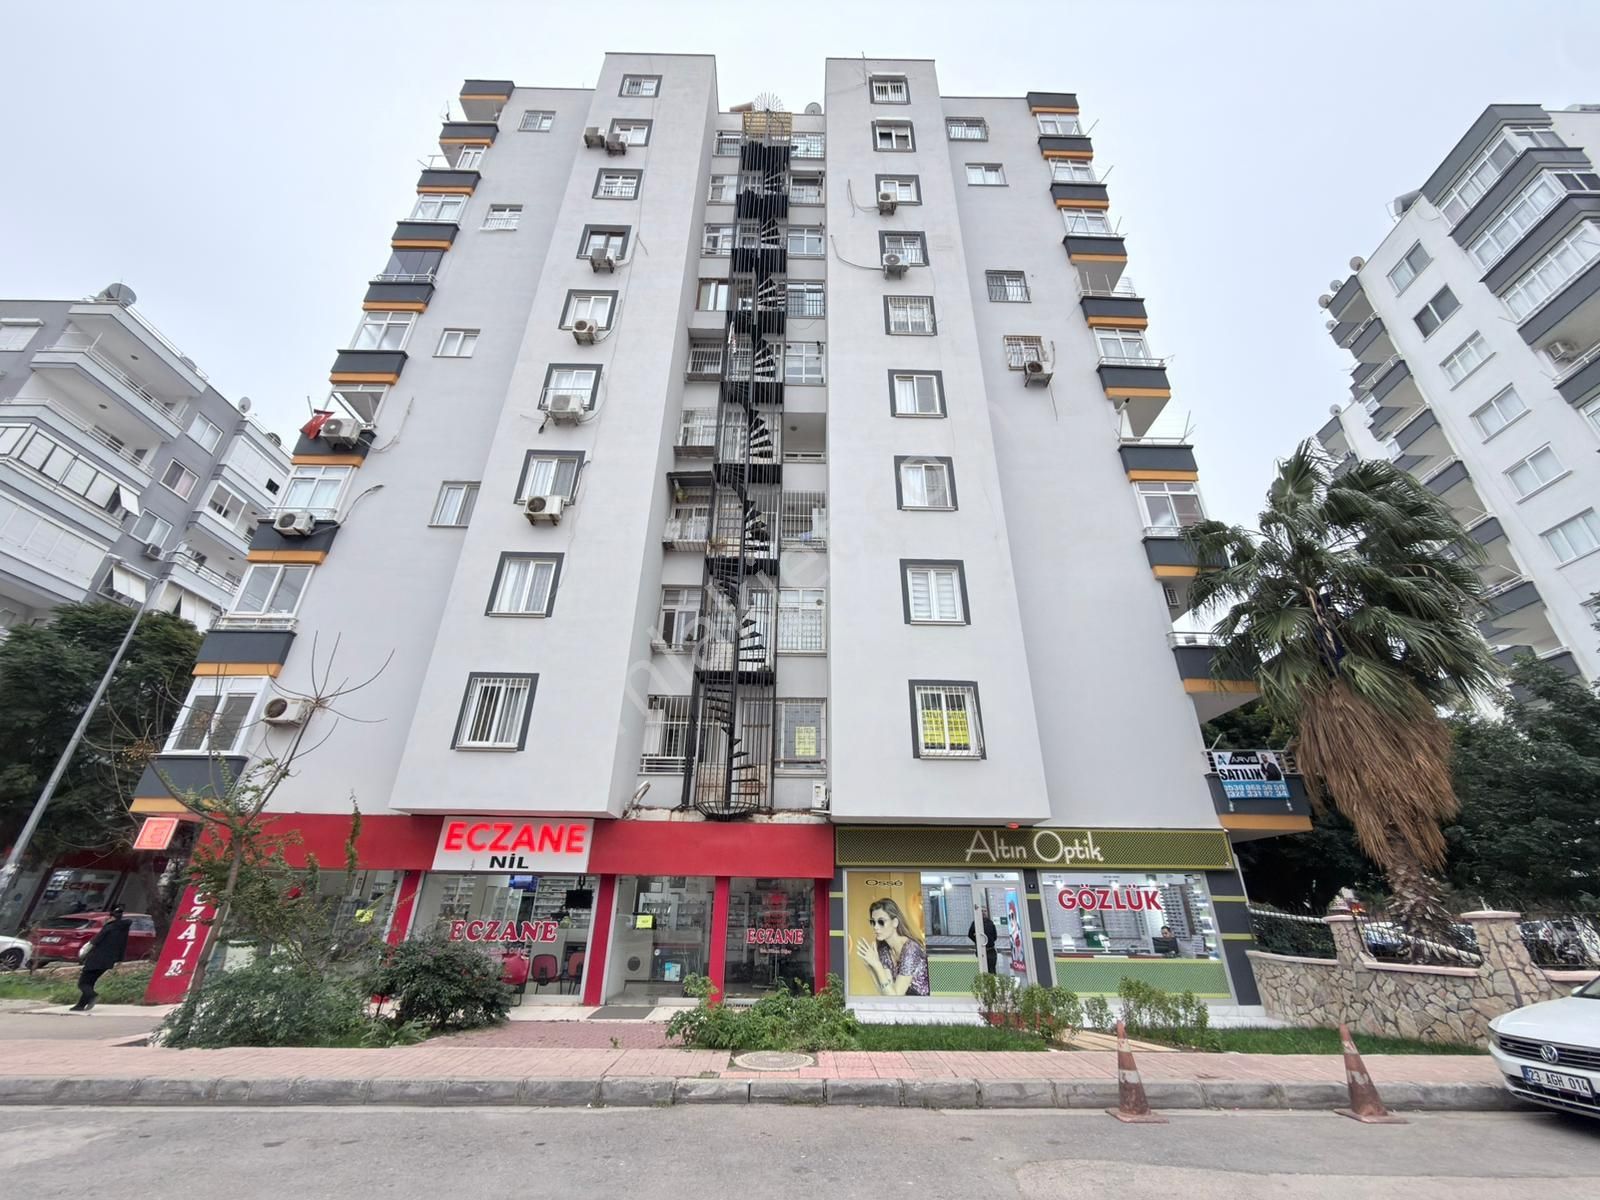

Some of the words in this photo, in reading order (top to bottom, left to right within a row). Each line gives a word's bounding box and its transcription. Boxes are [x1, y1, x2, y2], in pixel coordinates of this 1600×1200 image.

[1219, 769, 1264, 781] SATILIK
[444, 821, 588, 853] ECZANE
[965, 830, 1027, 862] Altın
[1033, 830, 1104, 864] Optik
[489, 853, 529, 869] NİL
[1058, 884, 1163, 912] GÖZLÜK
[449, 920, 558, 943] ECZANE
[746, 928, 804, 945] ECZANE
[1528, 1069, 1541, 1082] 23
[1546, 1072, 1565, 1087] AGH
[1568, 1077, 1589, 1092] 014
